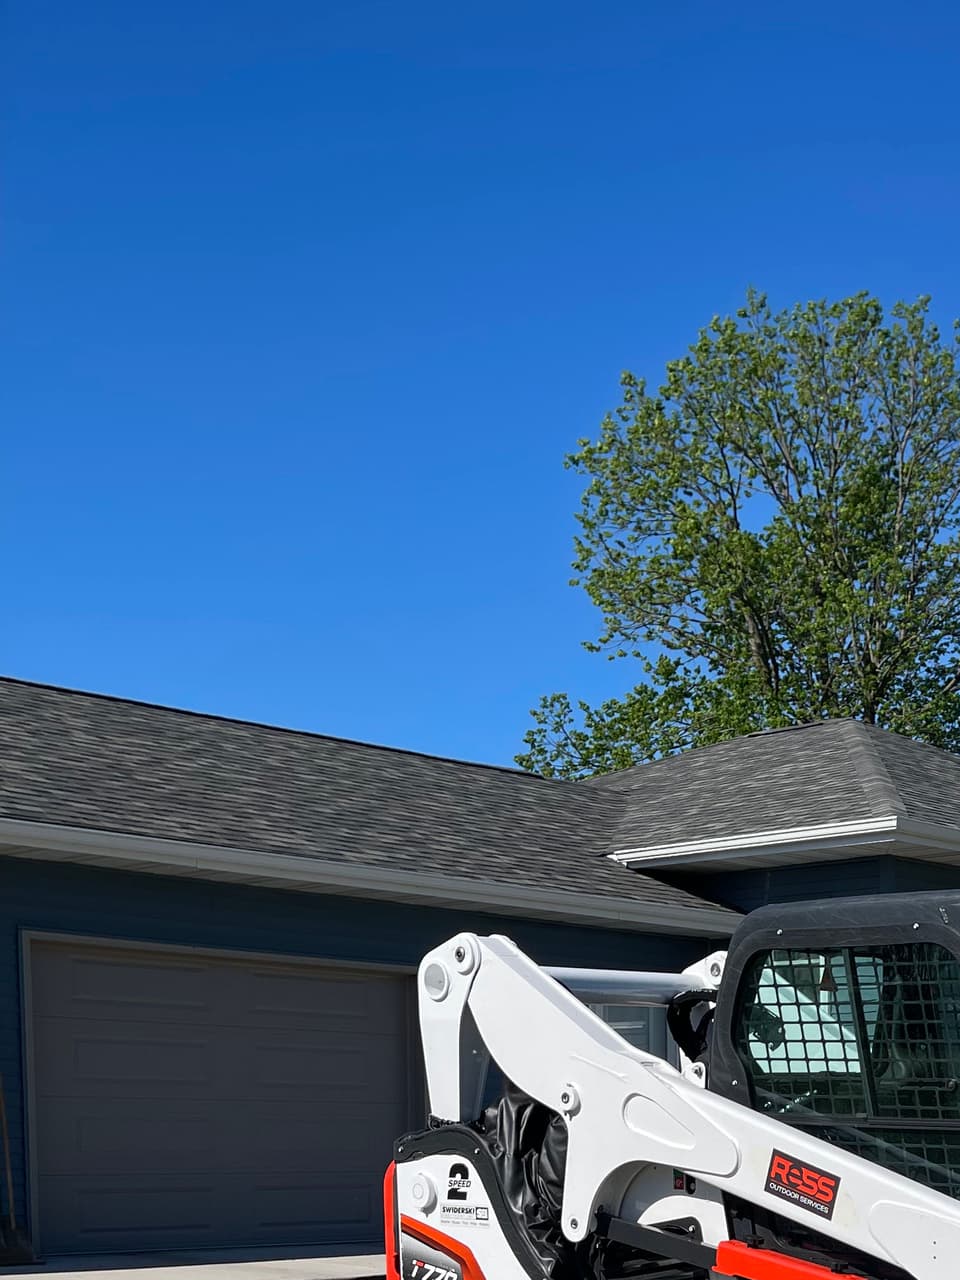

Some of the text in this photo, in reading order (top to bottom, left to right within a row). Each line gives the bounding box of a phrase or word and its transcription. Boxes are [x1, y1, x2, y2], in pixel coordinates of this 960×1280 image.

[447, 1162, 469, 1200] 2
[448, 1179, 471, 1188] SPEED
[769, 1182, 829, 1214] OUTDOOR SERVICES
[442, 1206, 475, 1214] SWIDERSKI
